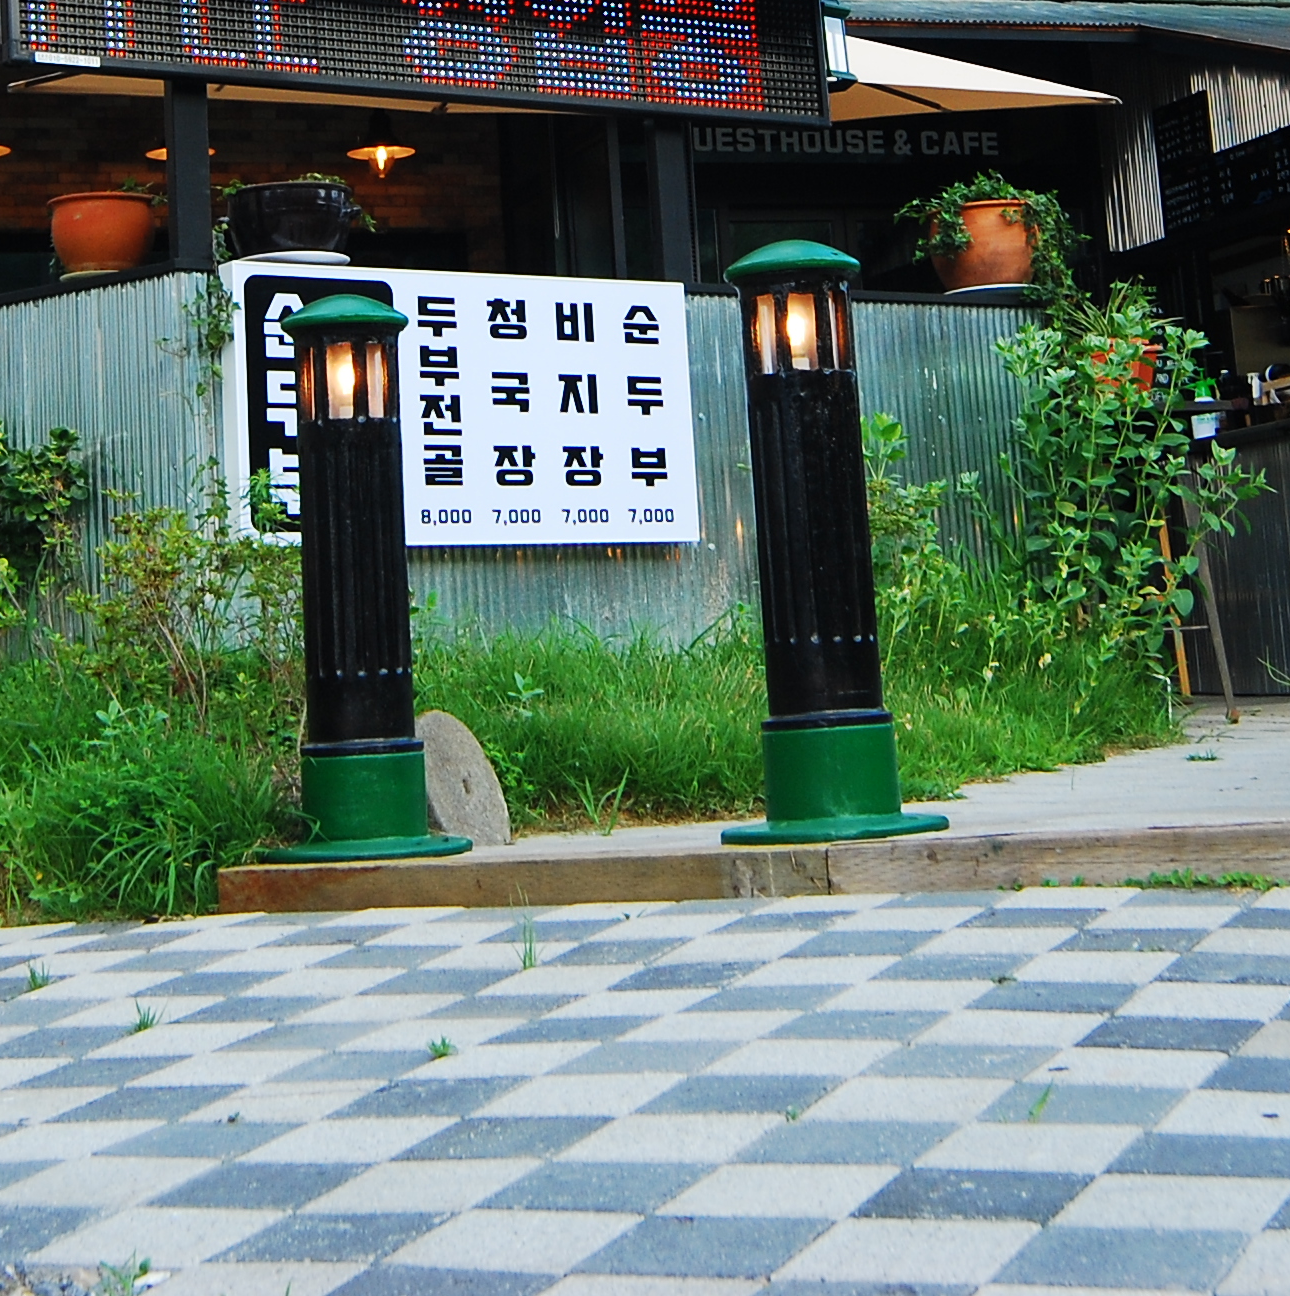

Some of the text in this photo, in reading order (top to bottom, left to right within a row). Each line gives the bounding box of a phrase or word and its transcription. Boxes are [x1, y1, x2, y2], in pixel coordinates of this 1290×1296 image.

[692, 125, 1000, 157] UESTHOUSE & CAFE
[416, 295, 465, 487] 두부전골
[486, 297, 537, 487] 청국장
[554, 301, 605, 487] 비지장
[622, 304, 669, 488] 순두부
[420, 507, 675, 526] 8,000 7,000 7,000 7,000
